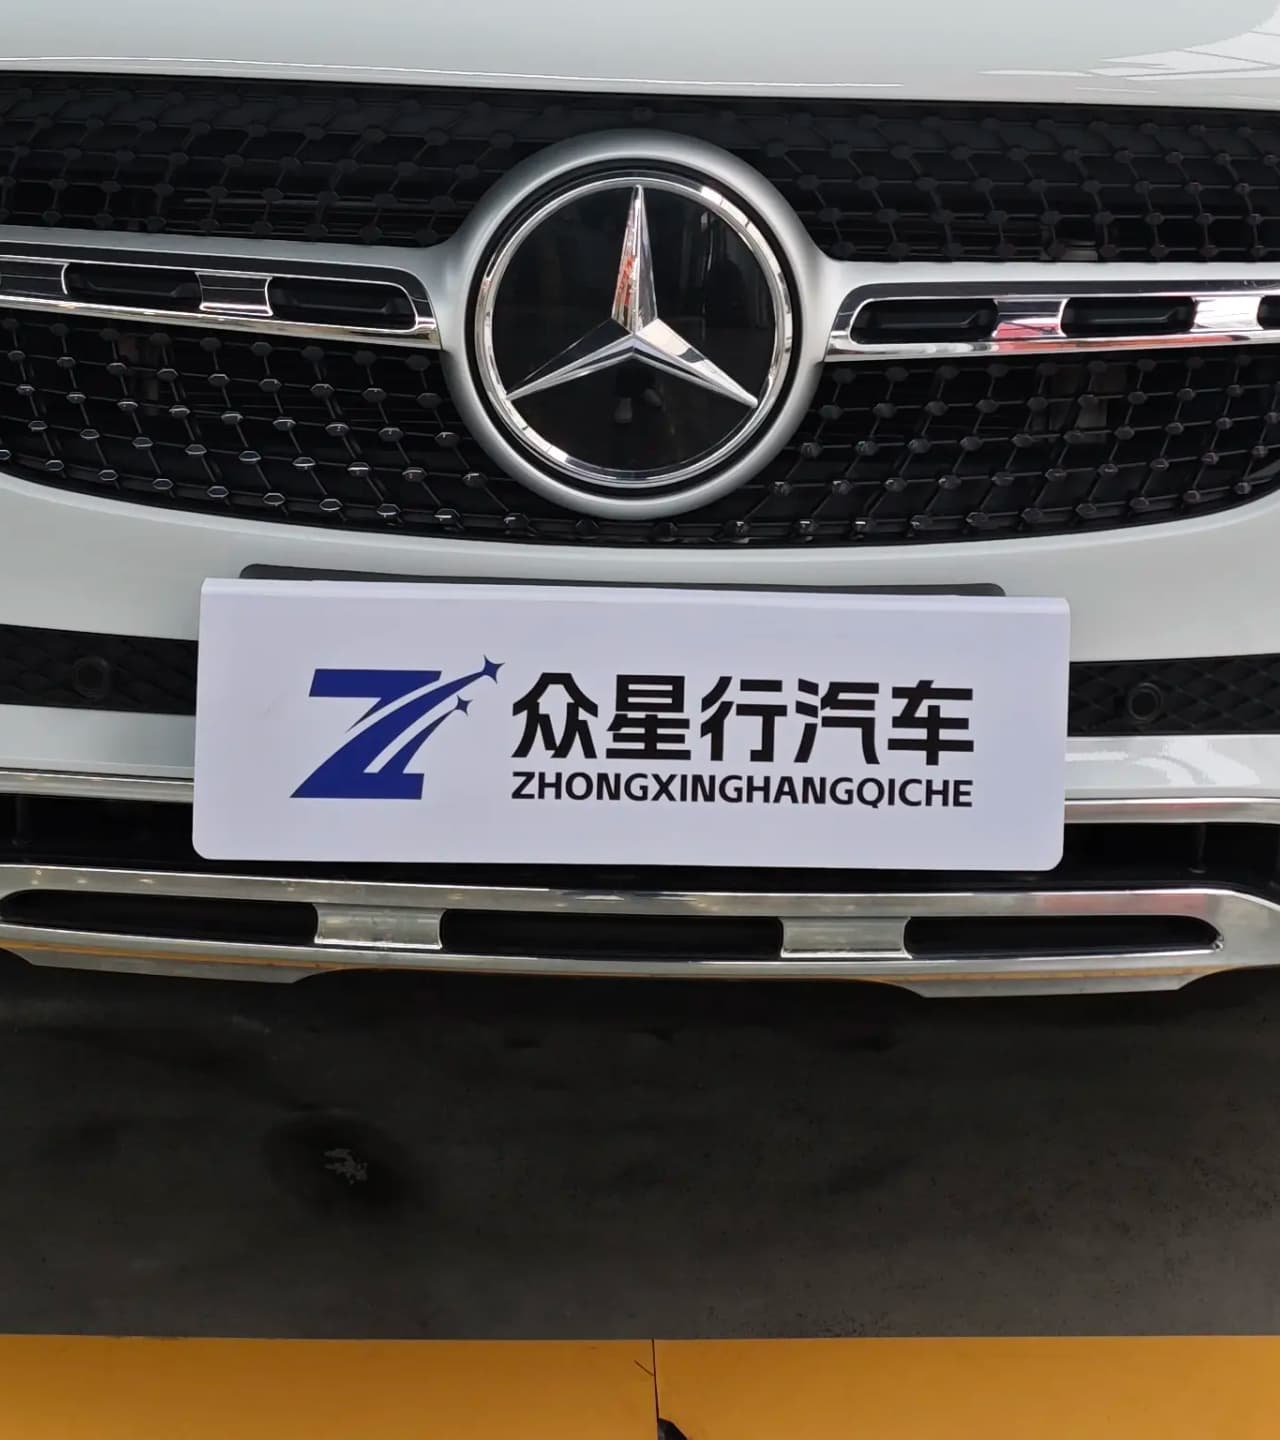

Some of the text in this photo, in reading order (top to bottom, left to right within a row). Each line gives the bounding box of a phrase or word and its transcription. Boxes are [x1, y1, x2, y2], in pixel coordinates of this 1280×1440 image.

[510, 670, 975, 767] 众星行汽车
[510, 770, 974, 809] ZHONGXINGHANGQICHE
